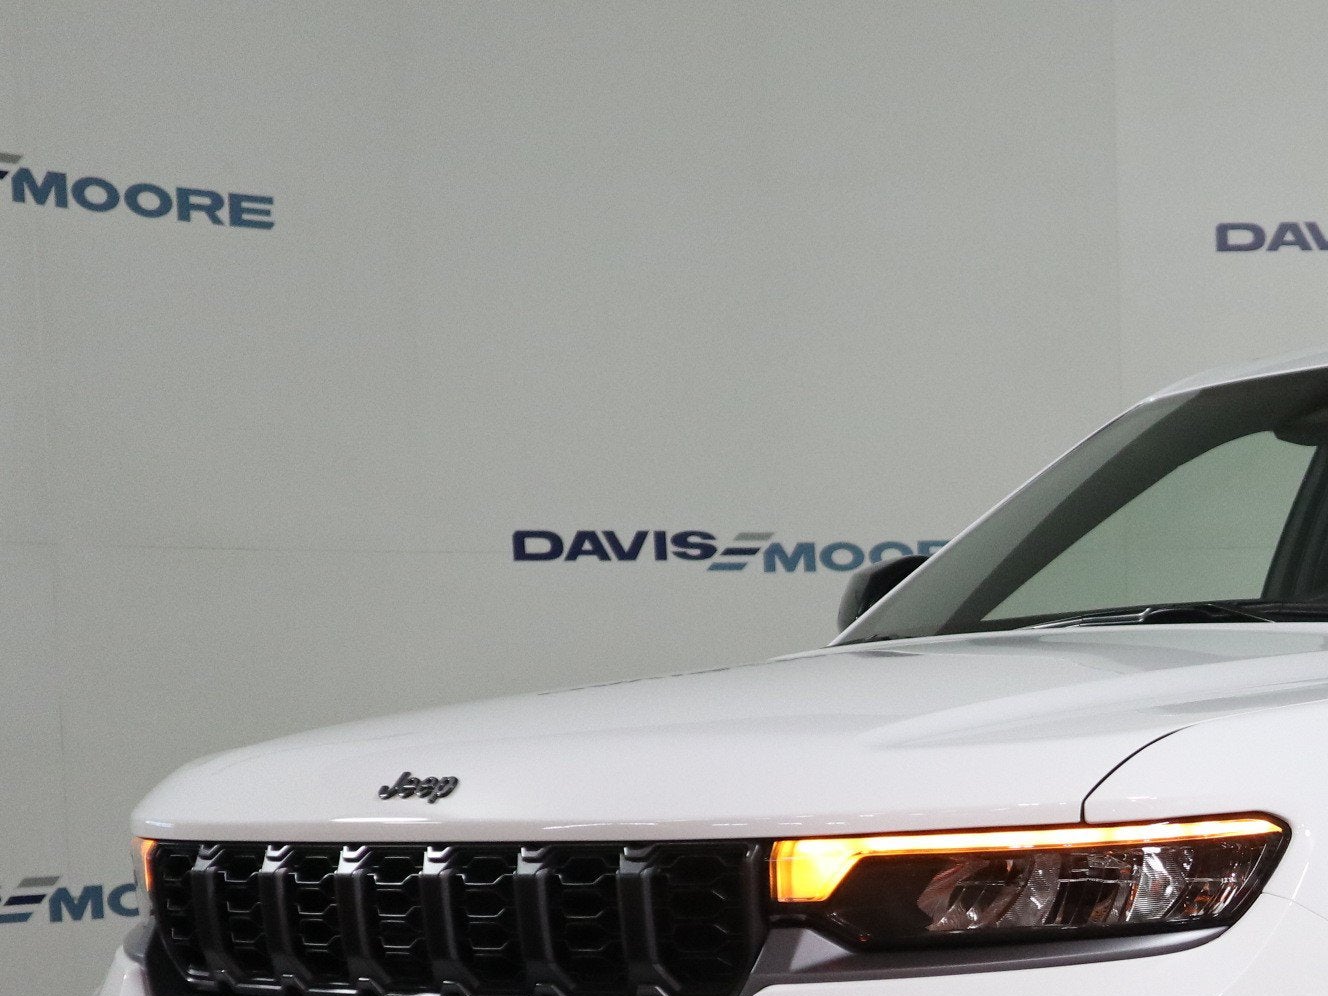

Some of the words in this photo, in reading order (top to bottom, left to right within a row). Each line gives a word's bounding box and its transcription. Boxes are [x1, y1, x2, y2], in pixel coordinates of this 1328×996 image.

[11, 167, 275, 230] MOORE
[512, 530, 718, 562] DAVIS
[378, 771, 459, 804] Jeep
